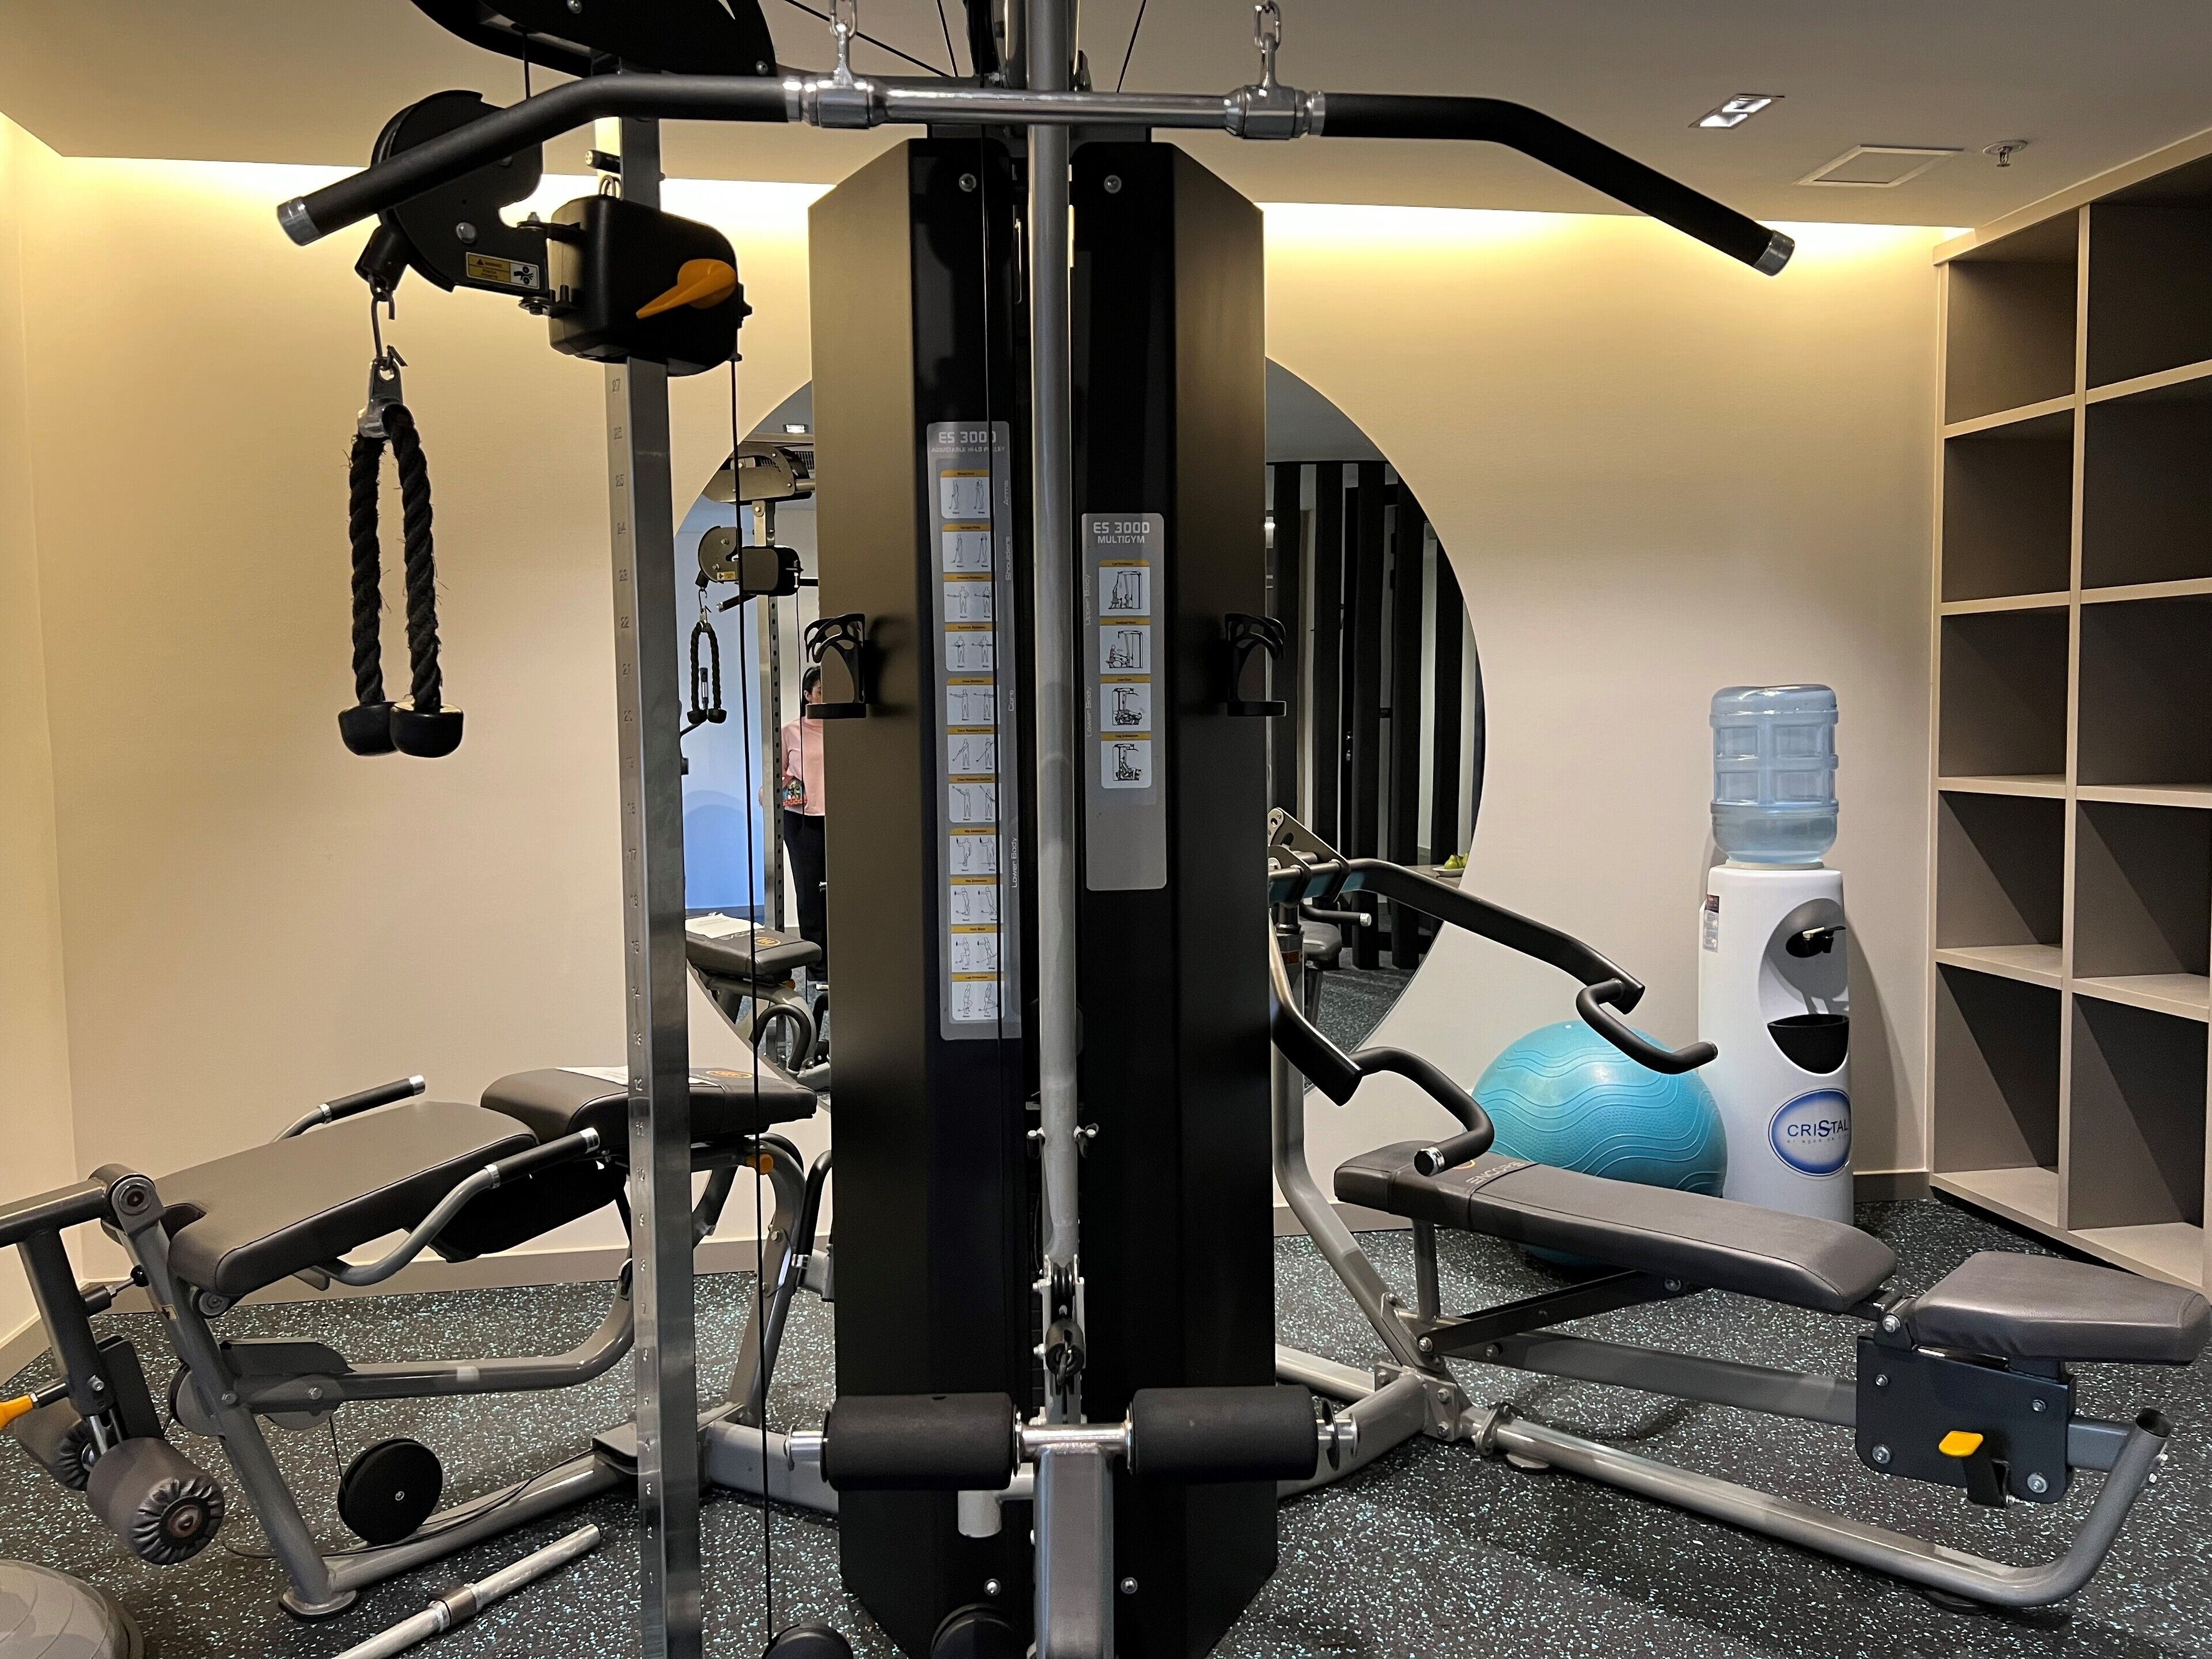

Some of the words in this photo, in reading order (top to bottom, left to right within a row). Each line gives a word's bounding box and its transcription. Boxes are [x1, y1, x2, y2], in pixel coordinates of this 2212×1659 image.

[612, 378, 621, 392] 27
[938, 431, 955, 444] ES
[1093, 522, 1109, 534] ES
[1114, 521, 1150, 534] 3000
[1097, 535, 1145, 544] MULTIGYM
[620, 616, 630, 628] 22
[1787, 1119, 1849, 1137] CRISTAL
